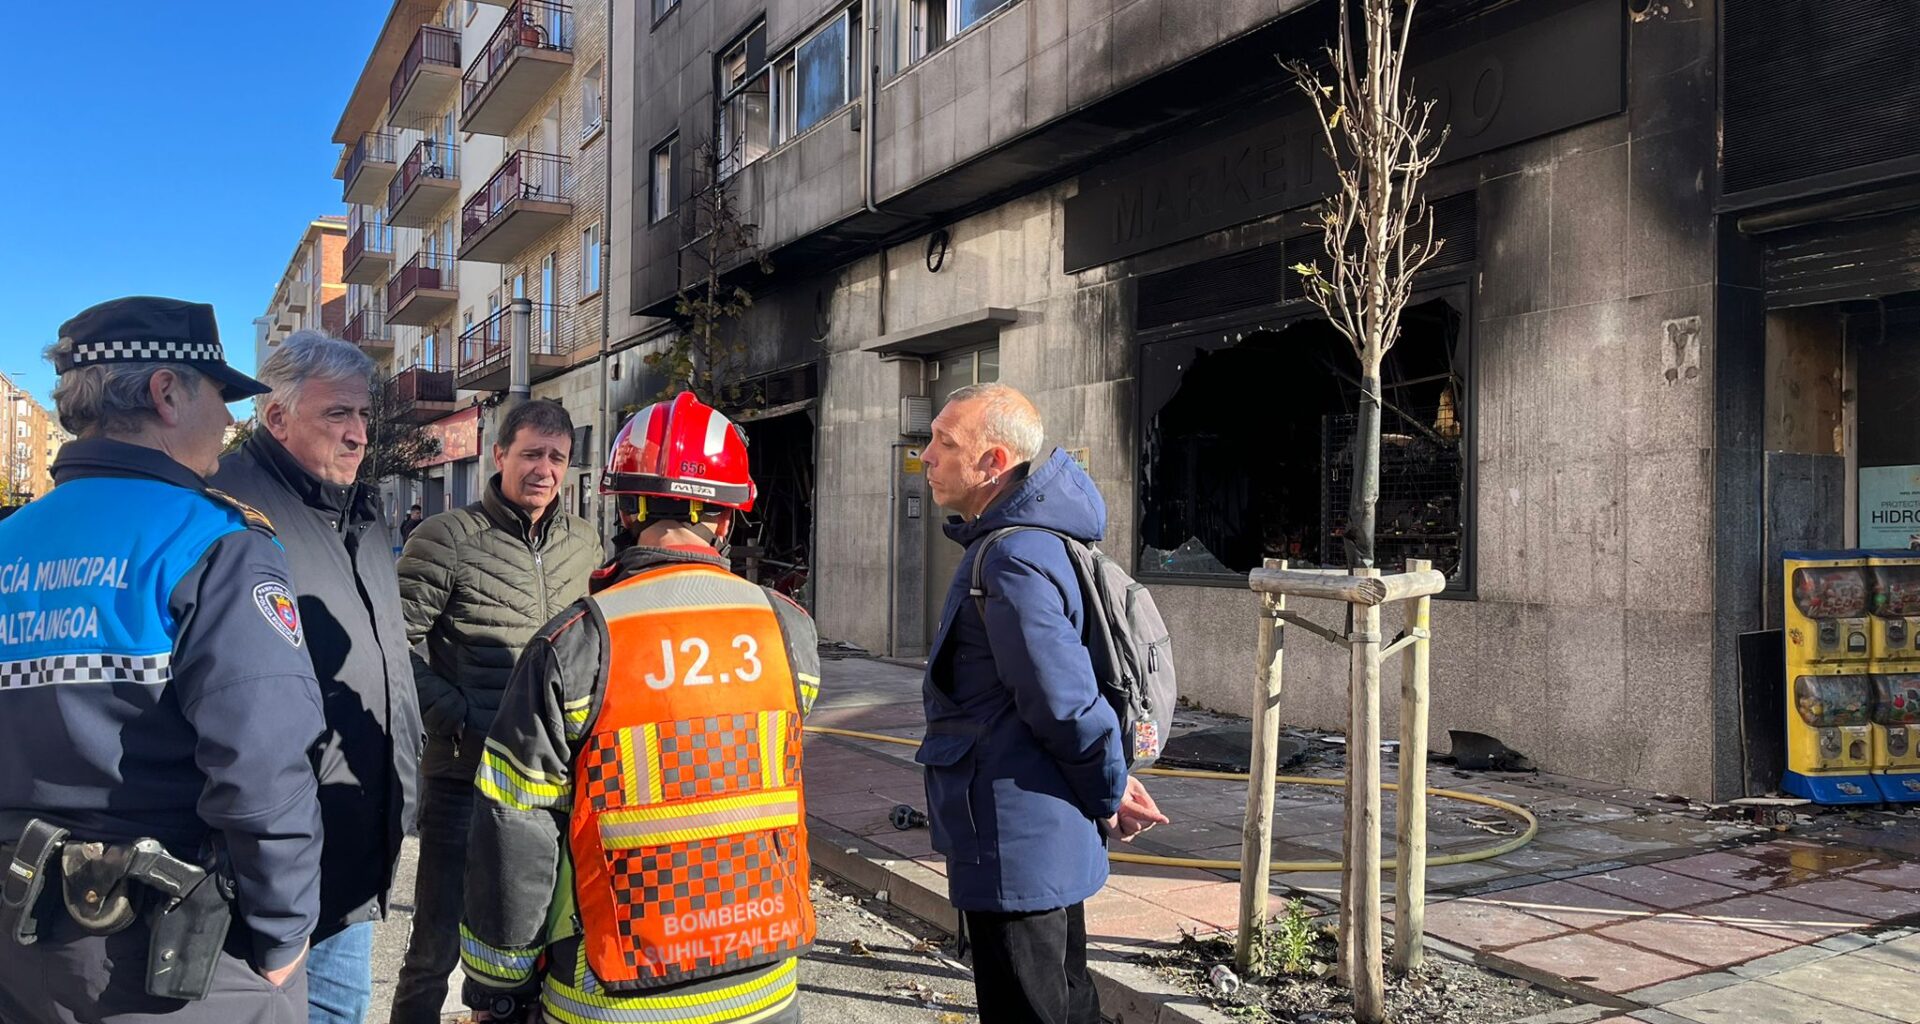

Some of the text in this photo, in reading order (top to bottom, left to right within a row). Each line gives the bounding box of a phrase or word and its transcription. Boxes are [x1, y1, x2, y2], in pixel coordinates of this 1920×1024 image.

[1112, 128, 1330, 248] MARKET
[0, 556, 128, 594] CÍA MUNICIPAL
[644, 634, 762, 690] J2.3
[664, 895, 785, 936] BOMBEROS
[645, 919, 799, 965] SUHILTZAILEAK
